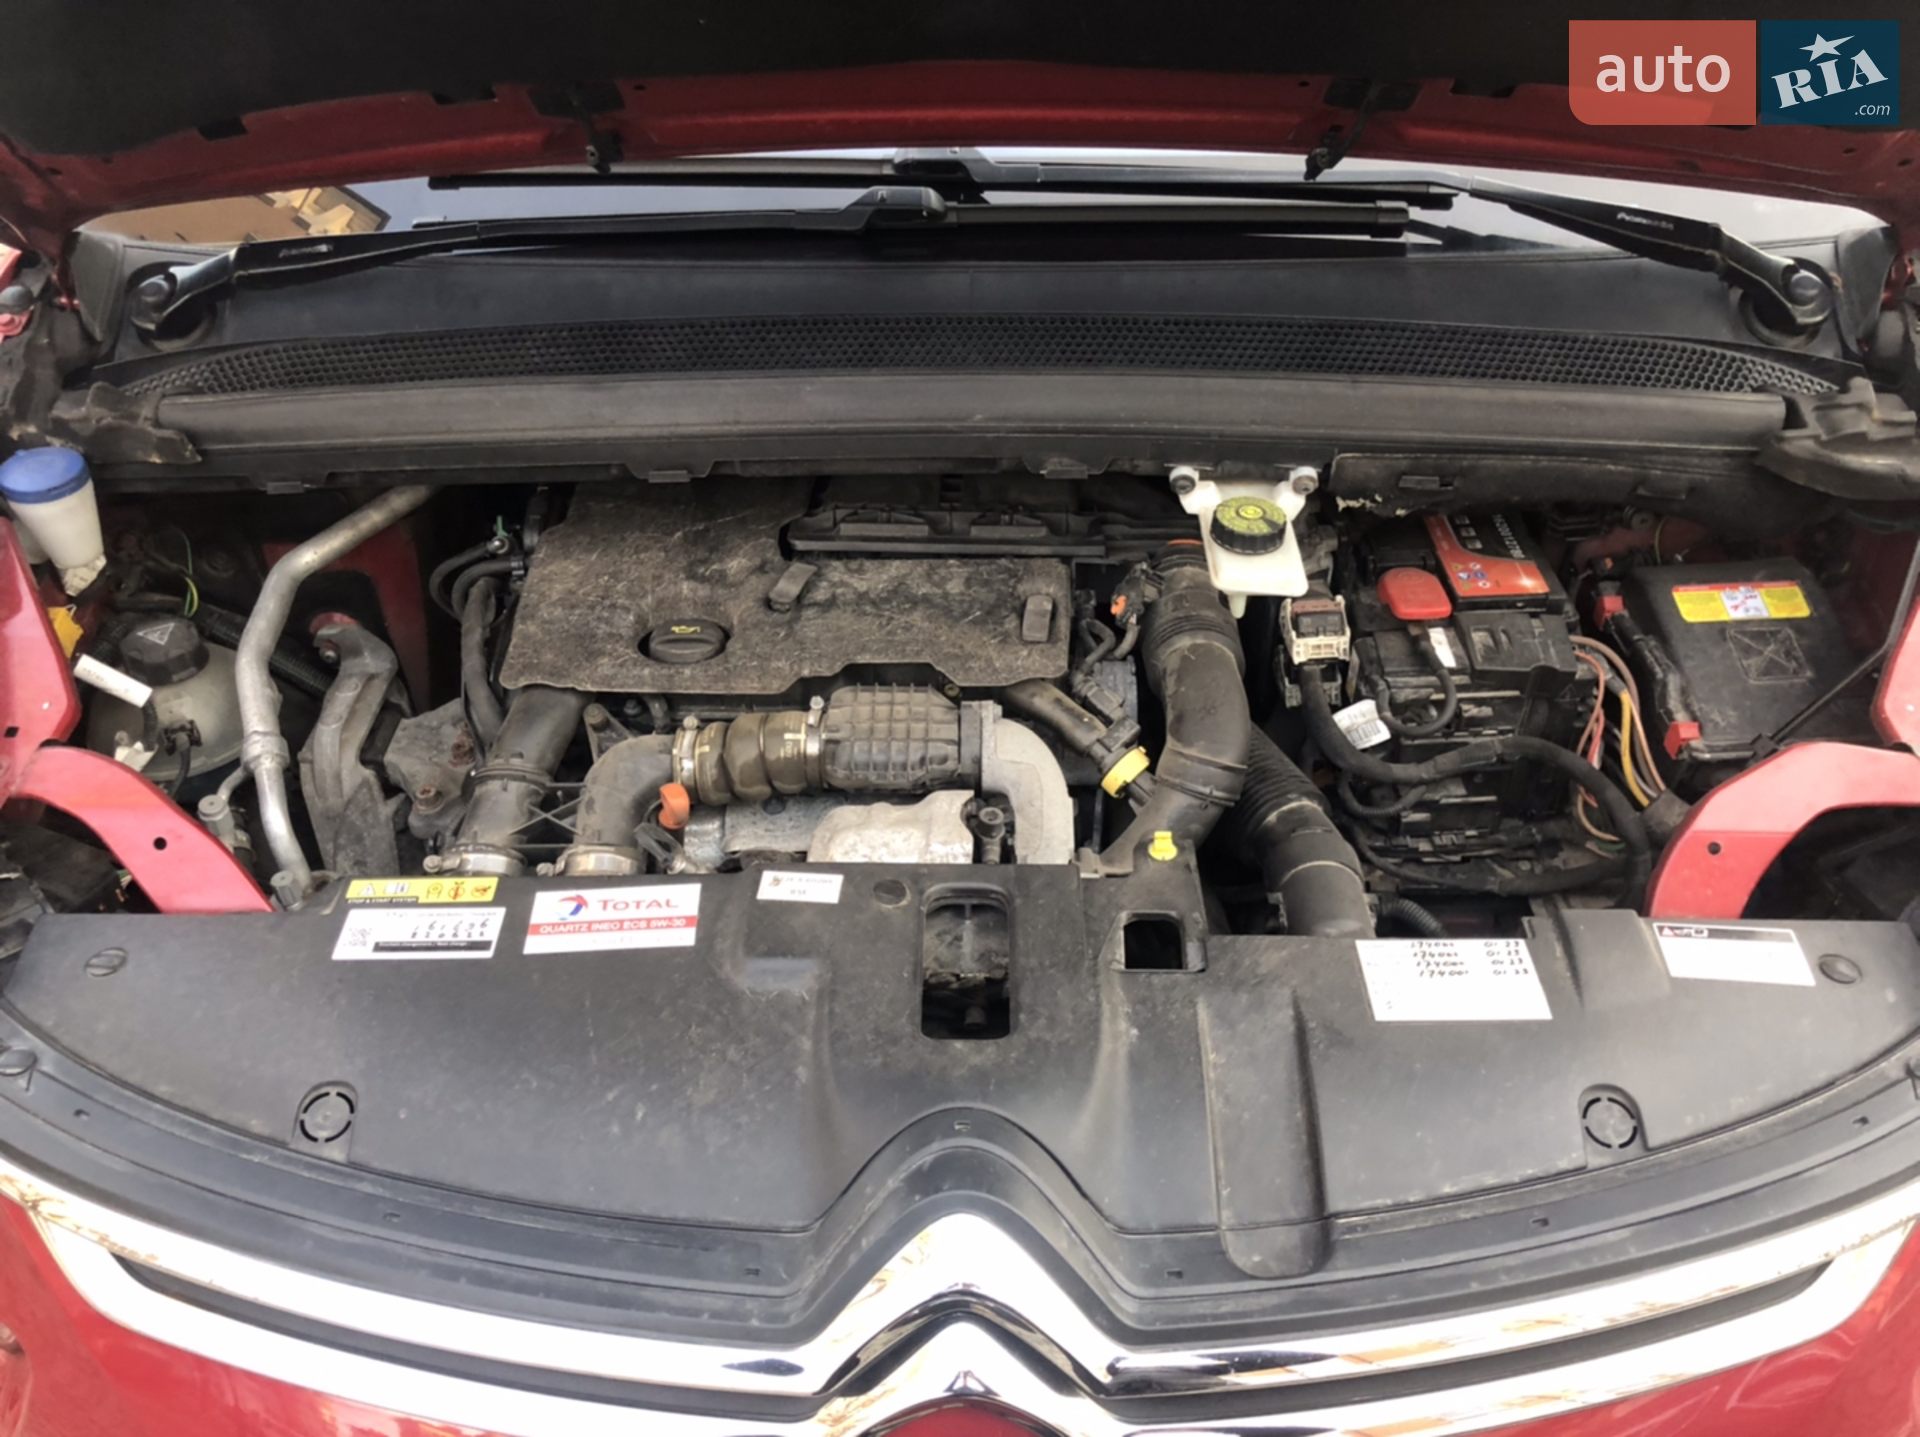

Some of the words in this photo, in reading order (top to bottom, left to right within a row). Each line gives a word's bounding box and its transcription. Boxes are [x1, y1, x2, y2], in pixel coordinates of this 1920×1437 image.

[539, 923, 590, 934] QUARTZ
[591, 921, 621, 932] INEO
[623, 920, 648, 930] ECS
[650, 918, 686, 929] 5W-30
